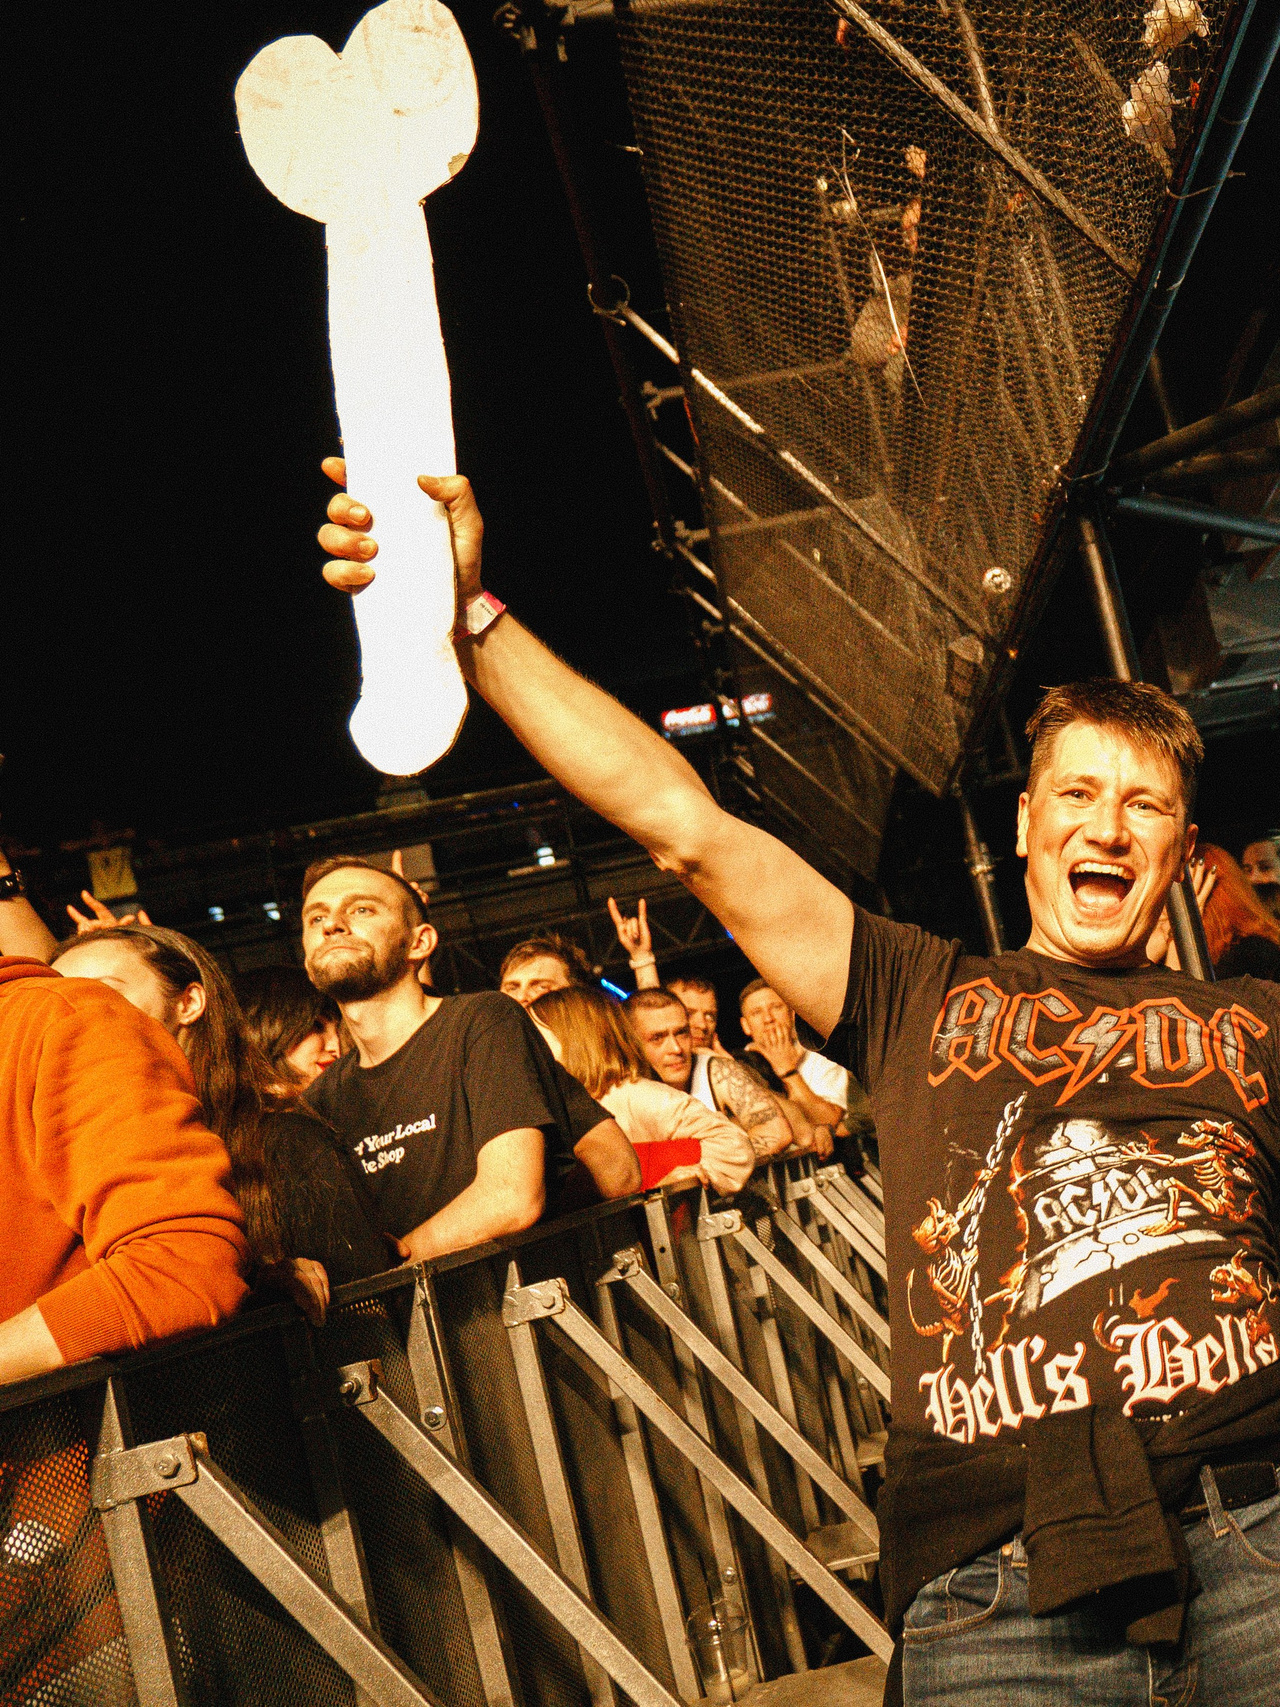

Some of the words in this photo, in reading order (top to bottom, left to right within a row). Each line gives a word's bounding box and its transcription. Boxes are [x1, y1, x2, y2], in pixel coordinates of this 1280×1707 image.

[363, 1131, 395, 1152] Your
[394, 1113, 436, 1140] Local
[377, 1147, 405, 1169] Shop
